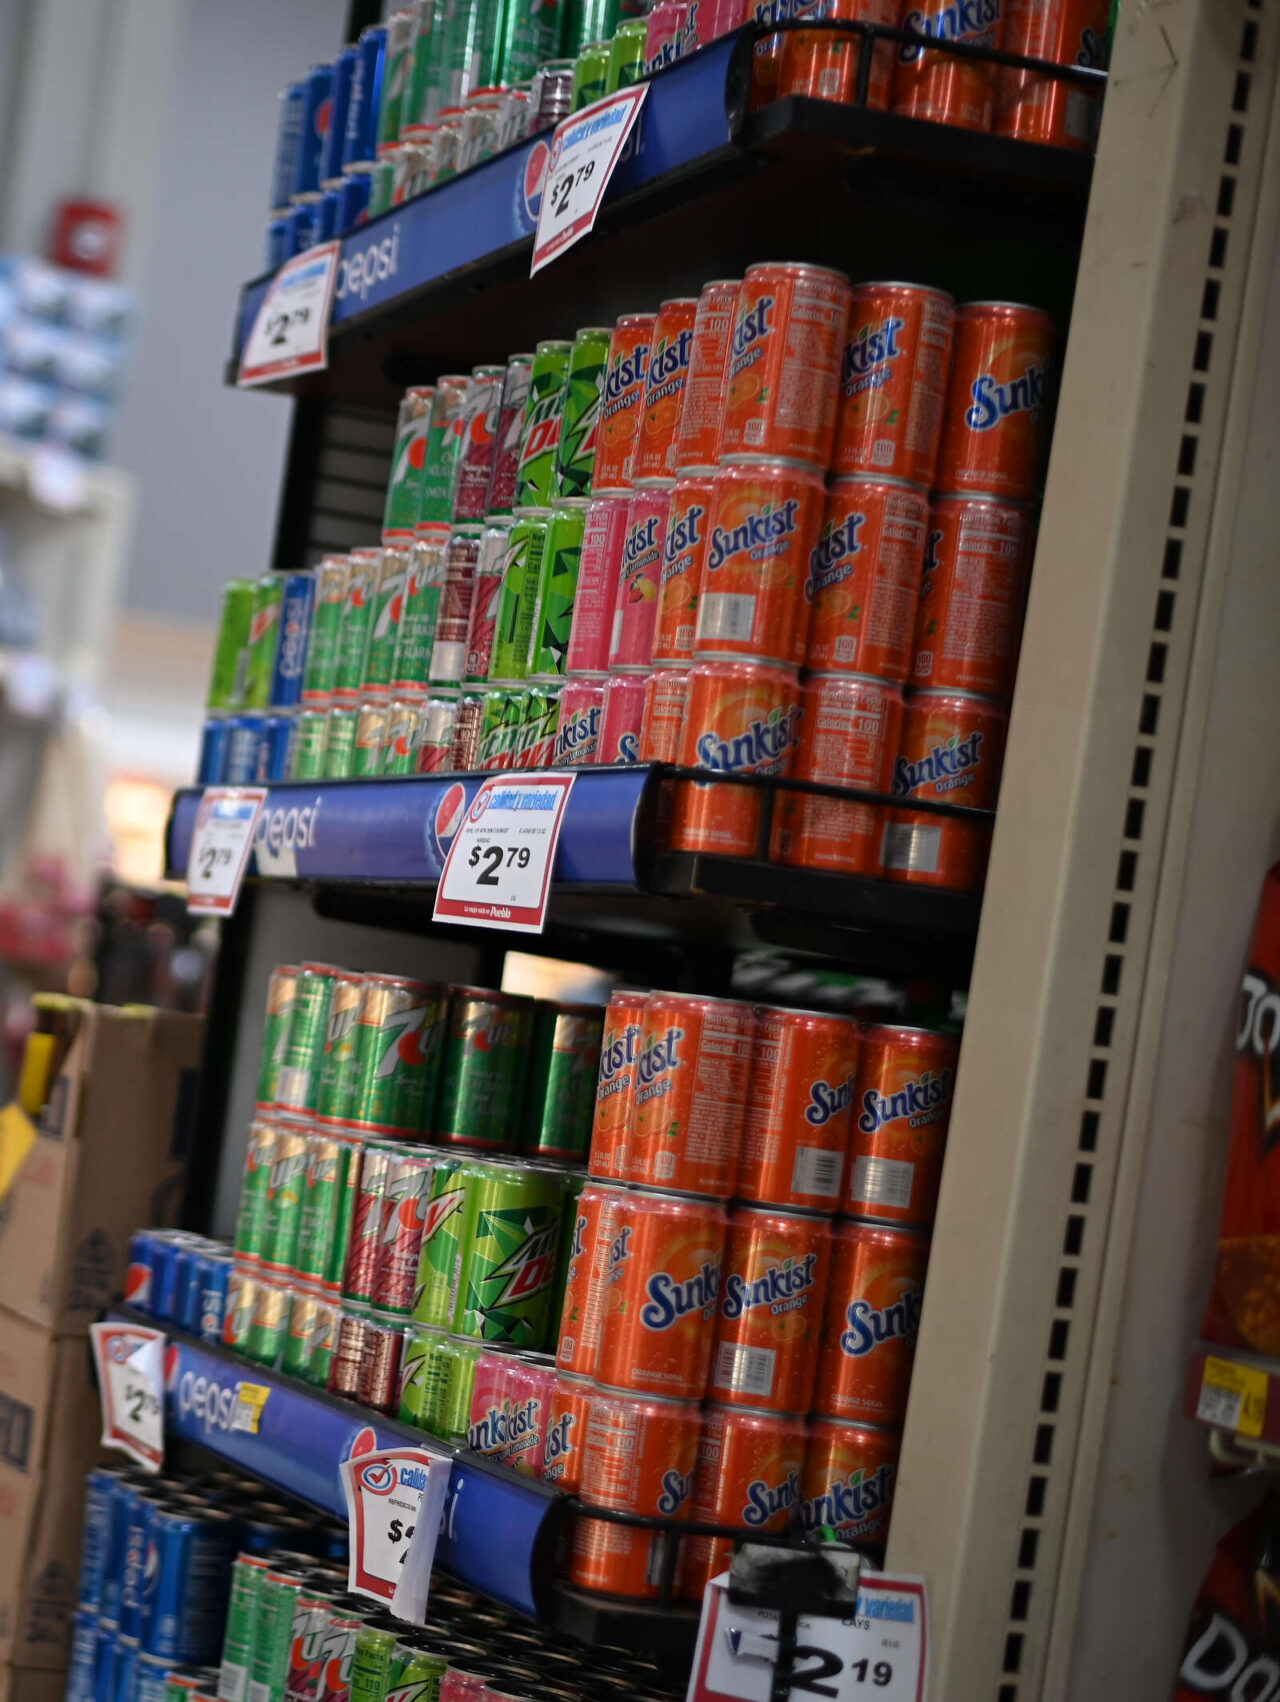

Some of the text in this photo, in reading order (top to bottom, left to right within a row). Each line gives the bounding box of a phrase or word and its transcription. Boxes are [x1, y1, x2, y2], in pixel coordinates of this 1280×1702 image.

[646, 377, 684, 407] Orange
[845, 367, 892, 397] Orange
[708, 500, 800, 570] Sunkist
[750, 540, 791, 562] Orange
[858, 718, 880, 733] 100
[891, 732, 985, 797] Sunkist
[936, 772, 976, 793] Orange
[701, 1039, 734, 1052] Calories
[858, 1068, 953, 1134] Sunkist
[723, 1253, 817, 1320] Sunkist
[771, 1294, 808, 1315] Orange
[611, 1436, 635, 1450] 100
